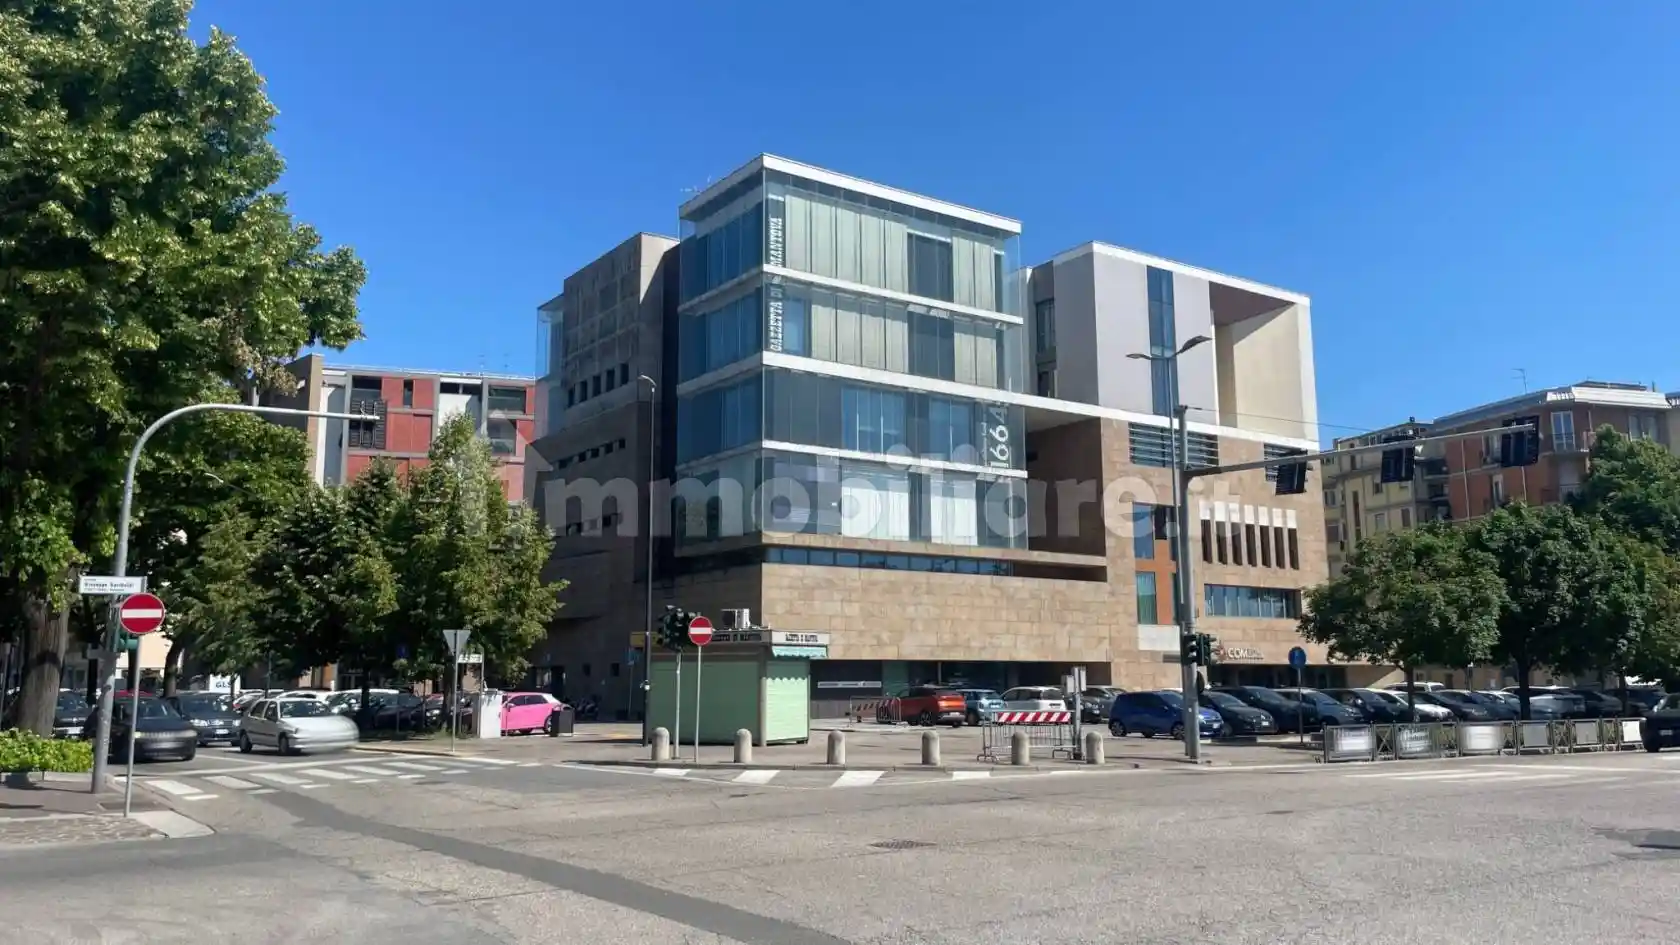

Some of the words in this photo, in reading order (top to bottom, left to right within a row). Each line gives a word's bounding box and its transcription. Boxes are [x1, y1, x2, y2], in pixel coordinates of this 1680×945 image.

[768, 217, 783, 268] MANTOVA
[769, 286, 782, 299] DI
[768, 301, 783, 353] GAZZETTA
[989, 403, 1009, 469] 1664
